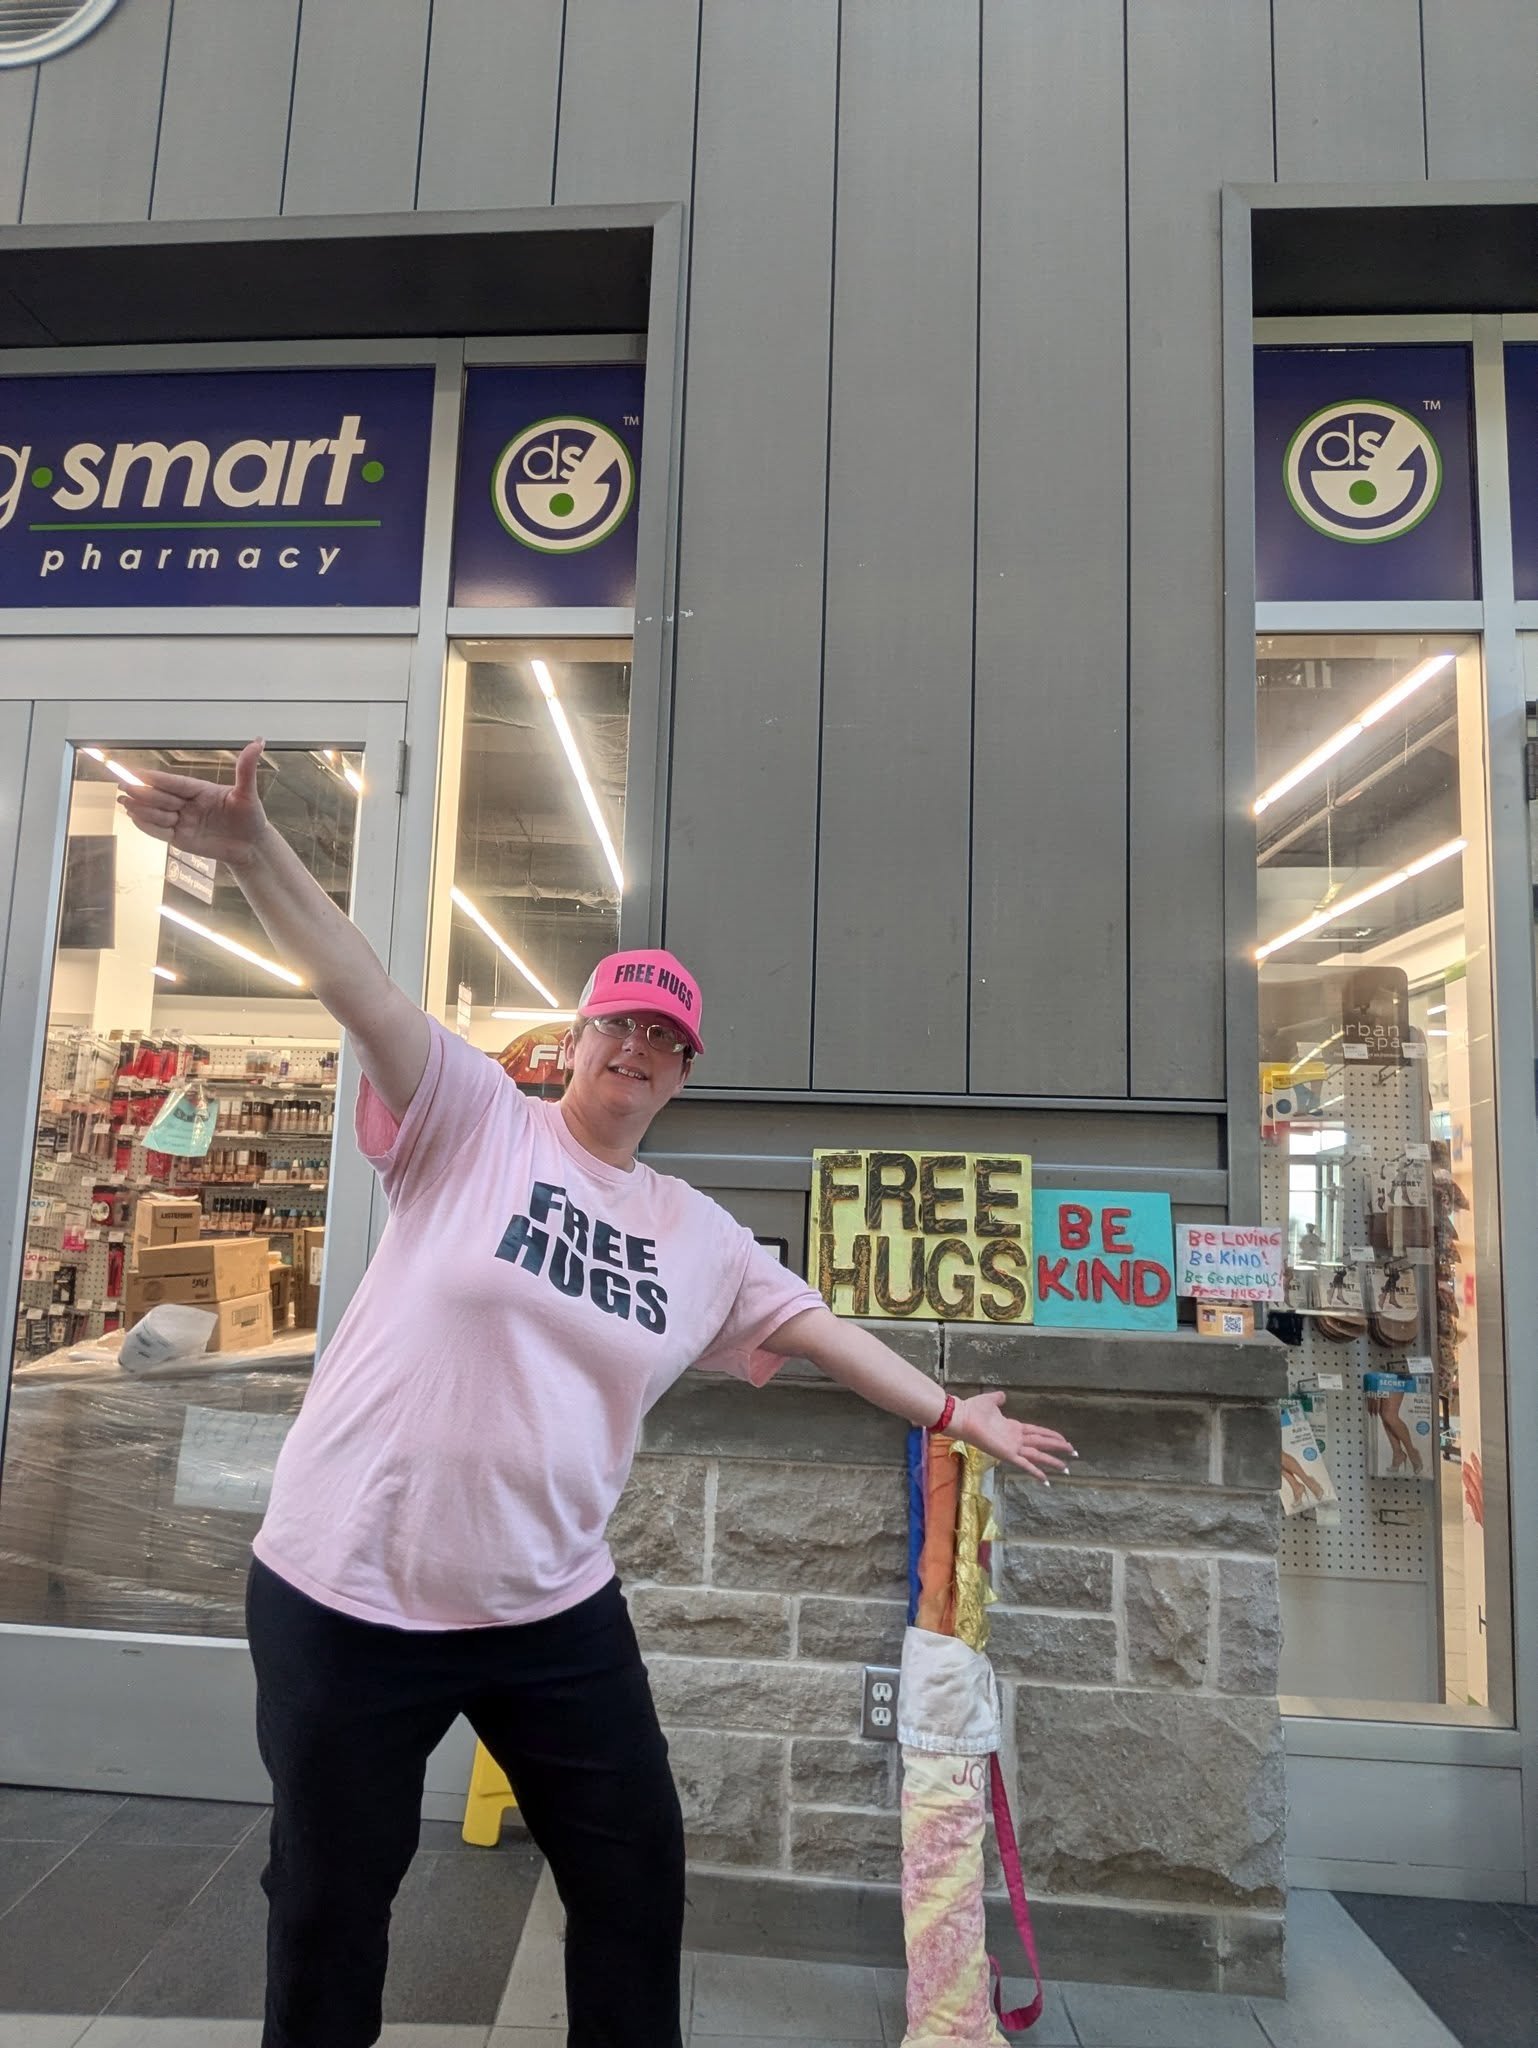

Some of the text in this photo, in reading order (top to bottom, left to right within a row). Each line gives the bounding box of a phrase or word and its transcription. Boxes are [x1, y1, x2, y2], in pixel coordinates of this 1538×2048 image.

[623, 416, 640, 426] TM
[1423, 400, 1441, 410] TM
[40, 543, 342, 577] pharmacy
[614, 963, 694, 1011] FREE HUGS
[1331, 1022, 1400, 1037] urban
[1364, 1037, 1401, 1051] spa
[818, 1152, 1022, 1238] FREE
[529, 1181, 659, 1277] FREE
[1059, 1203, 1135, 1254] BE
[494, 1214, 669, 1335] HUGS
[818, 1232, 1028, 1321] HUGS
[1037, 1255, 1171, 1307] KIND
[1379, 1379, 1406, 1387] SECRET
